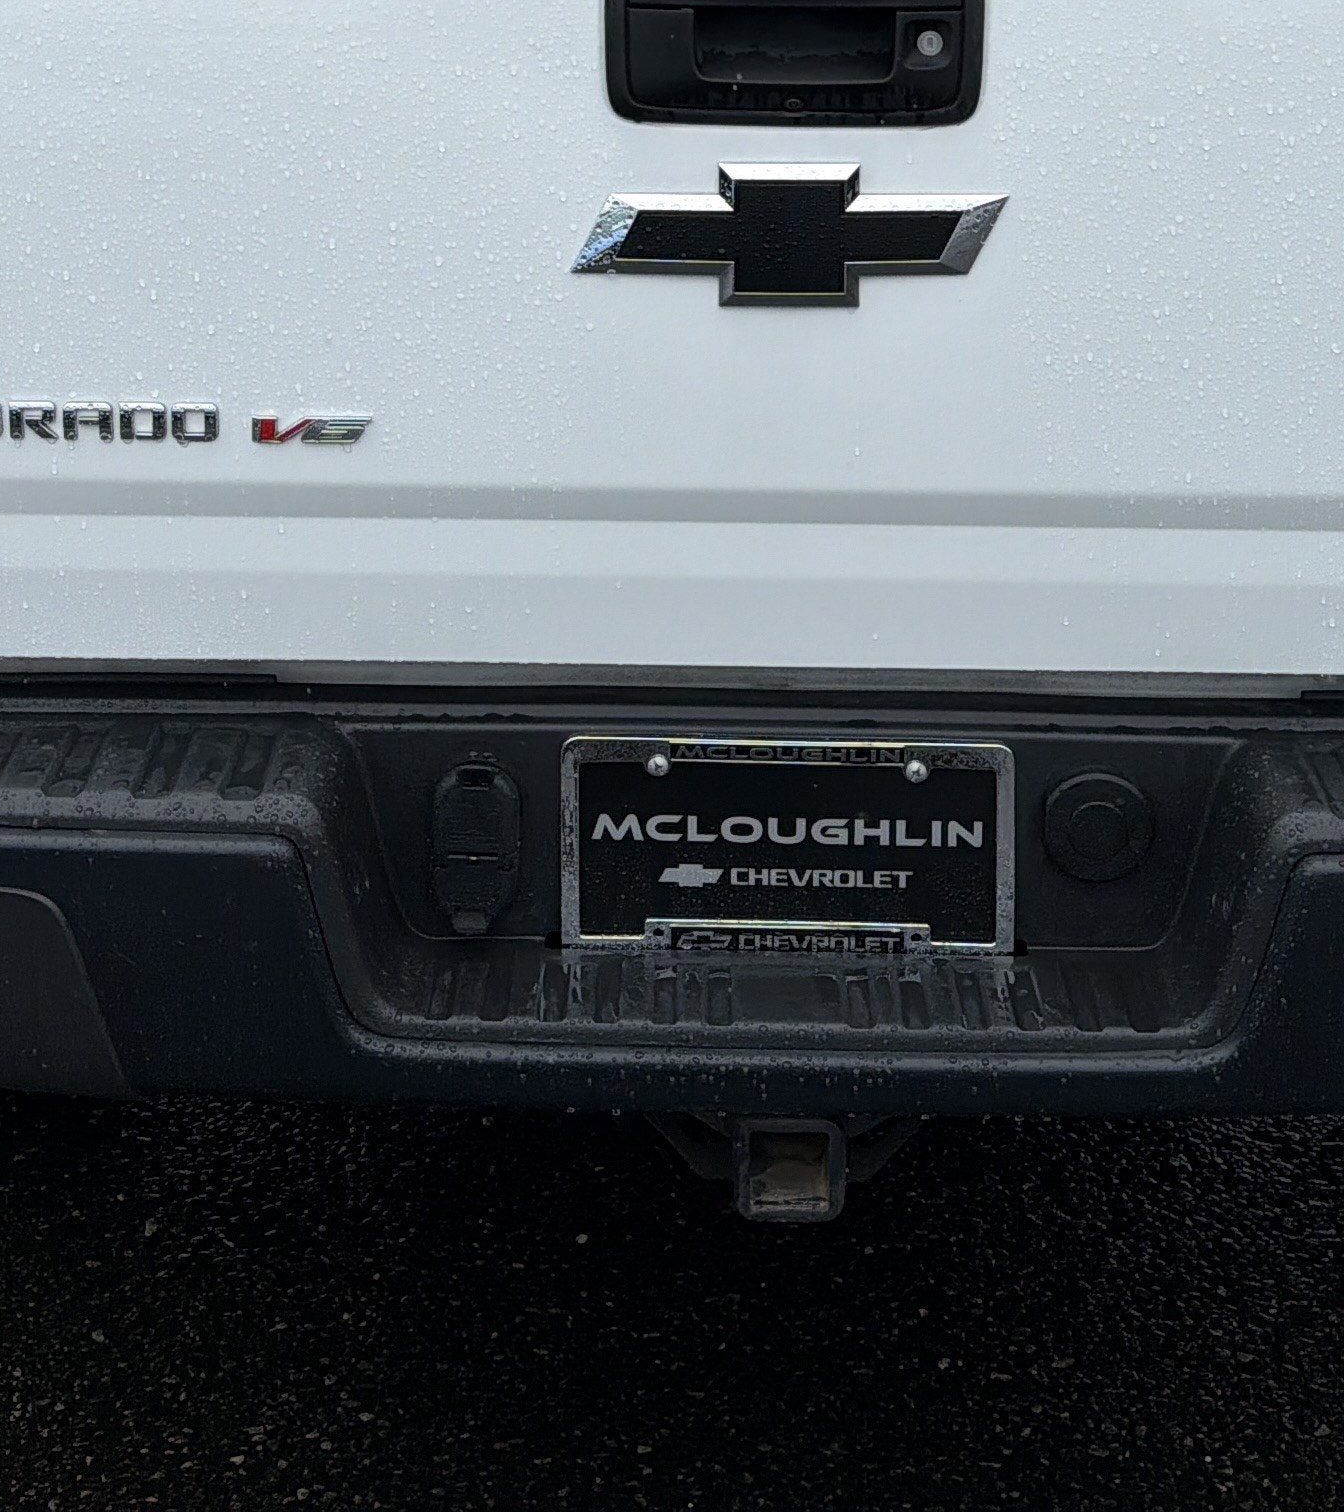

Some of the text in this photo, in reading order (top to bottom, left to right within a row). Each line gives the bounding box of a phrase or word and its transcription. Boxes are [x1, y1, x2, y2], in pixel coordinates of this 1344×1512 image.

[252, 415, 372, 443] V6
[675, 744, 900, 763] MCLOUGHLIN
[591, 813, 984, 848] MCLOUGHLIN
[730, 867, 914, 889] CHEVROLET
[739, 933, 900, 954] CHEVROLET
